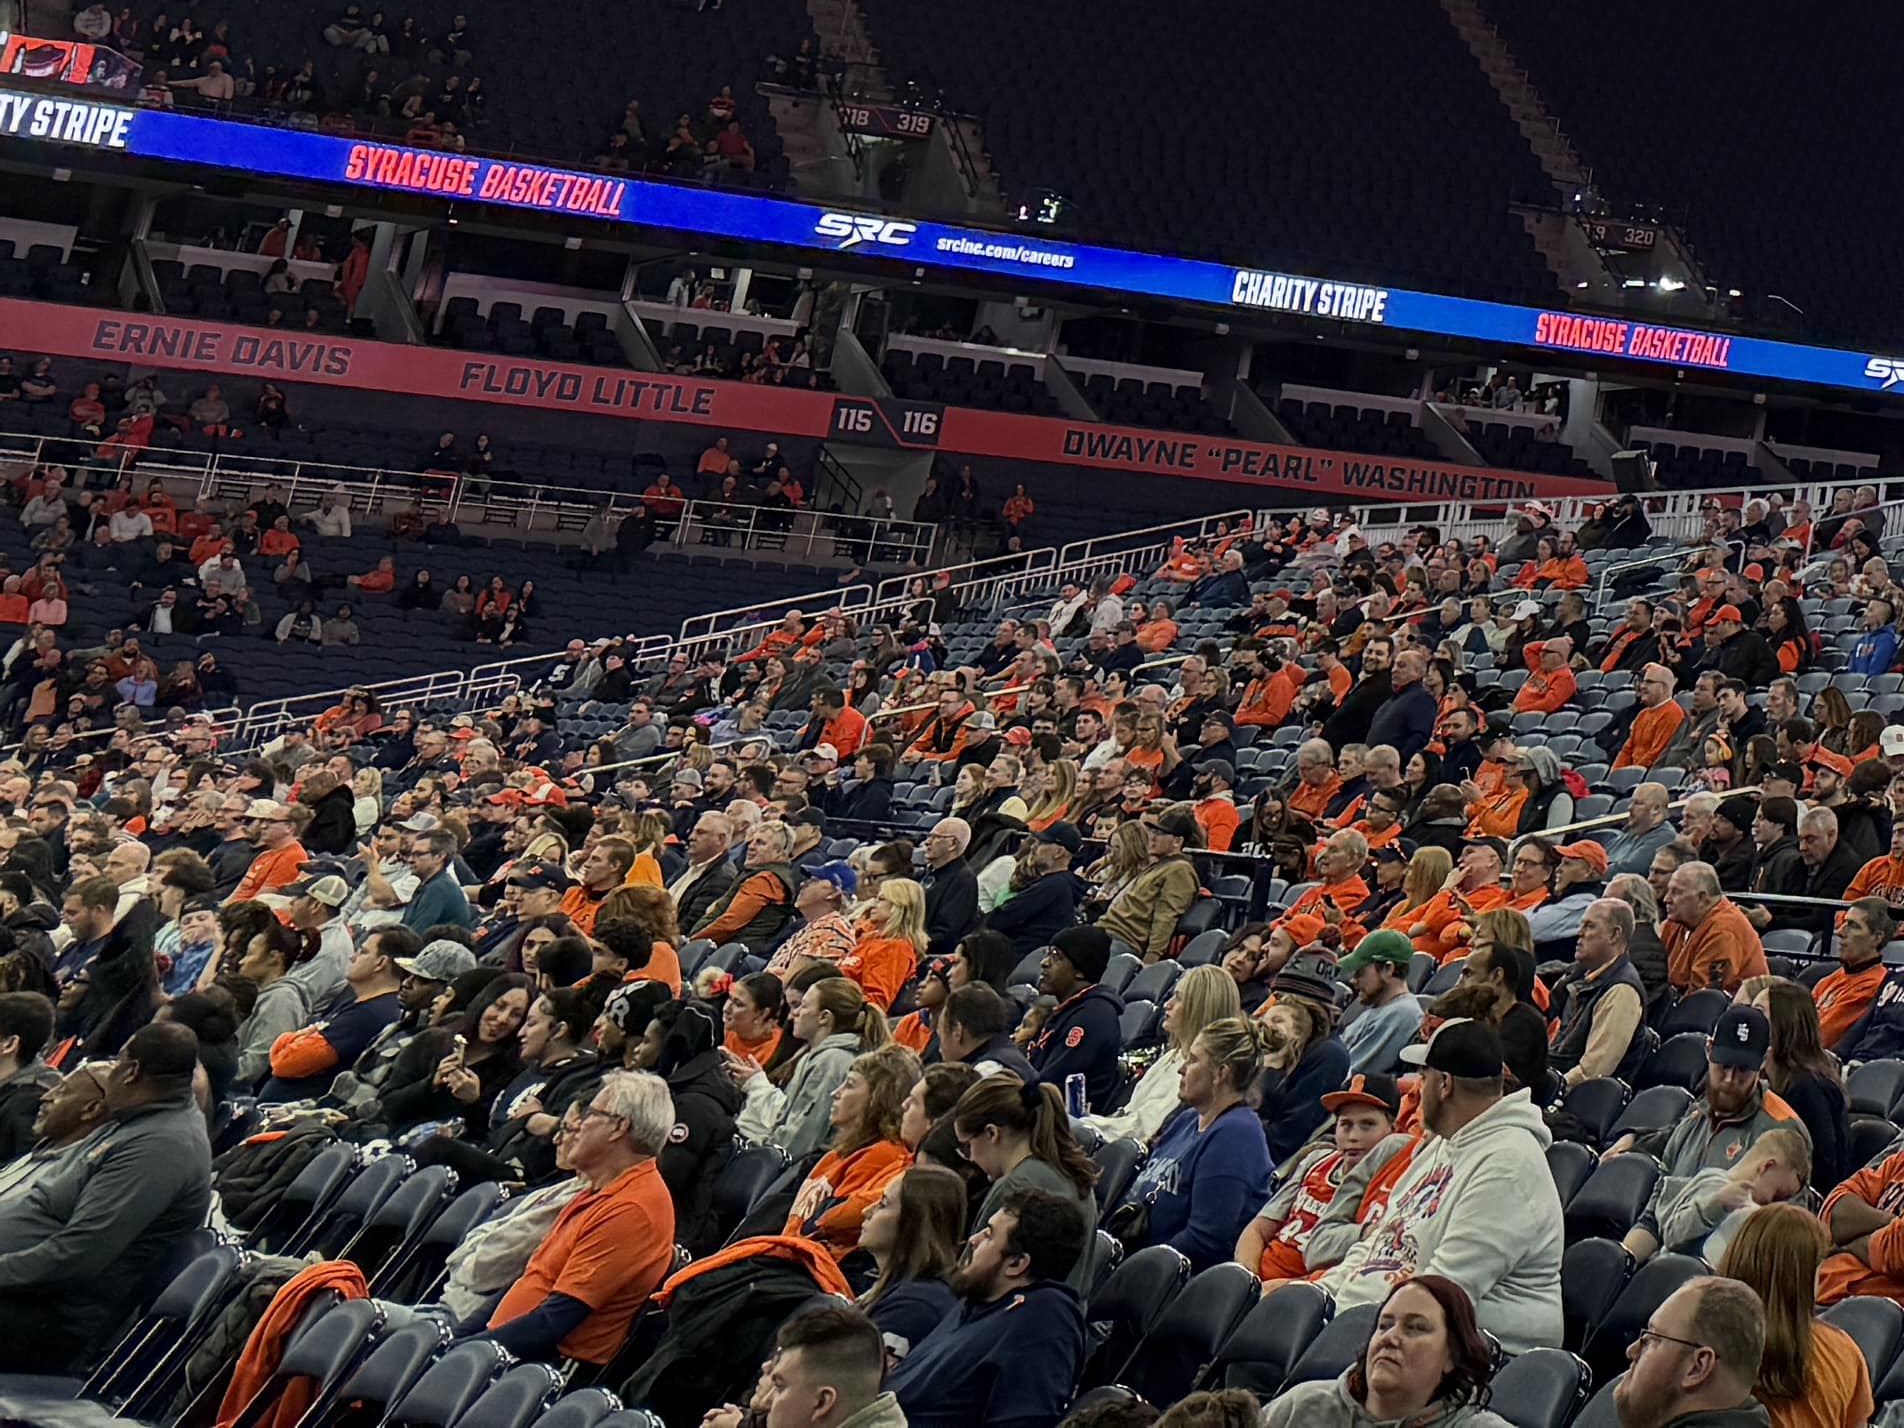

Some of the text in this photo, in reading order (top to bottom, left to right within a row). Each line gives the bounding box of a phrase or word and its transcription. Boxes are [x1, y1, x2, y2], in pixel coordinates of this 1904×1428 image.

[896, 115, 930, 135] 319
[30, 100, 133, 148] STRIPE
[346, 144, 479, 197] SYRACUSE
[480, 164, 625, 217] BASKETBALL
[814, 212, 917, 249] SRC
[1232, 271, 1317, 316] CHARITY
[1317, 282, 1388, 323] STRIPE
[1535, 313, 1628, 356] SYRACUSE
[1629, 325, 1729, 368] BASKETBALL
[1624, 227, 1655, 247] 320
[92, 320, 352, 376] ERNIE DAVIS
[459, 361, 715, 416] FLOYD LITTLE
[837, 406, 937, 435] 115 116
[1062, 428, 1197, 469] DWAYNE
[1343, 461, 1535, 501] WASHINGTON
